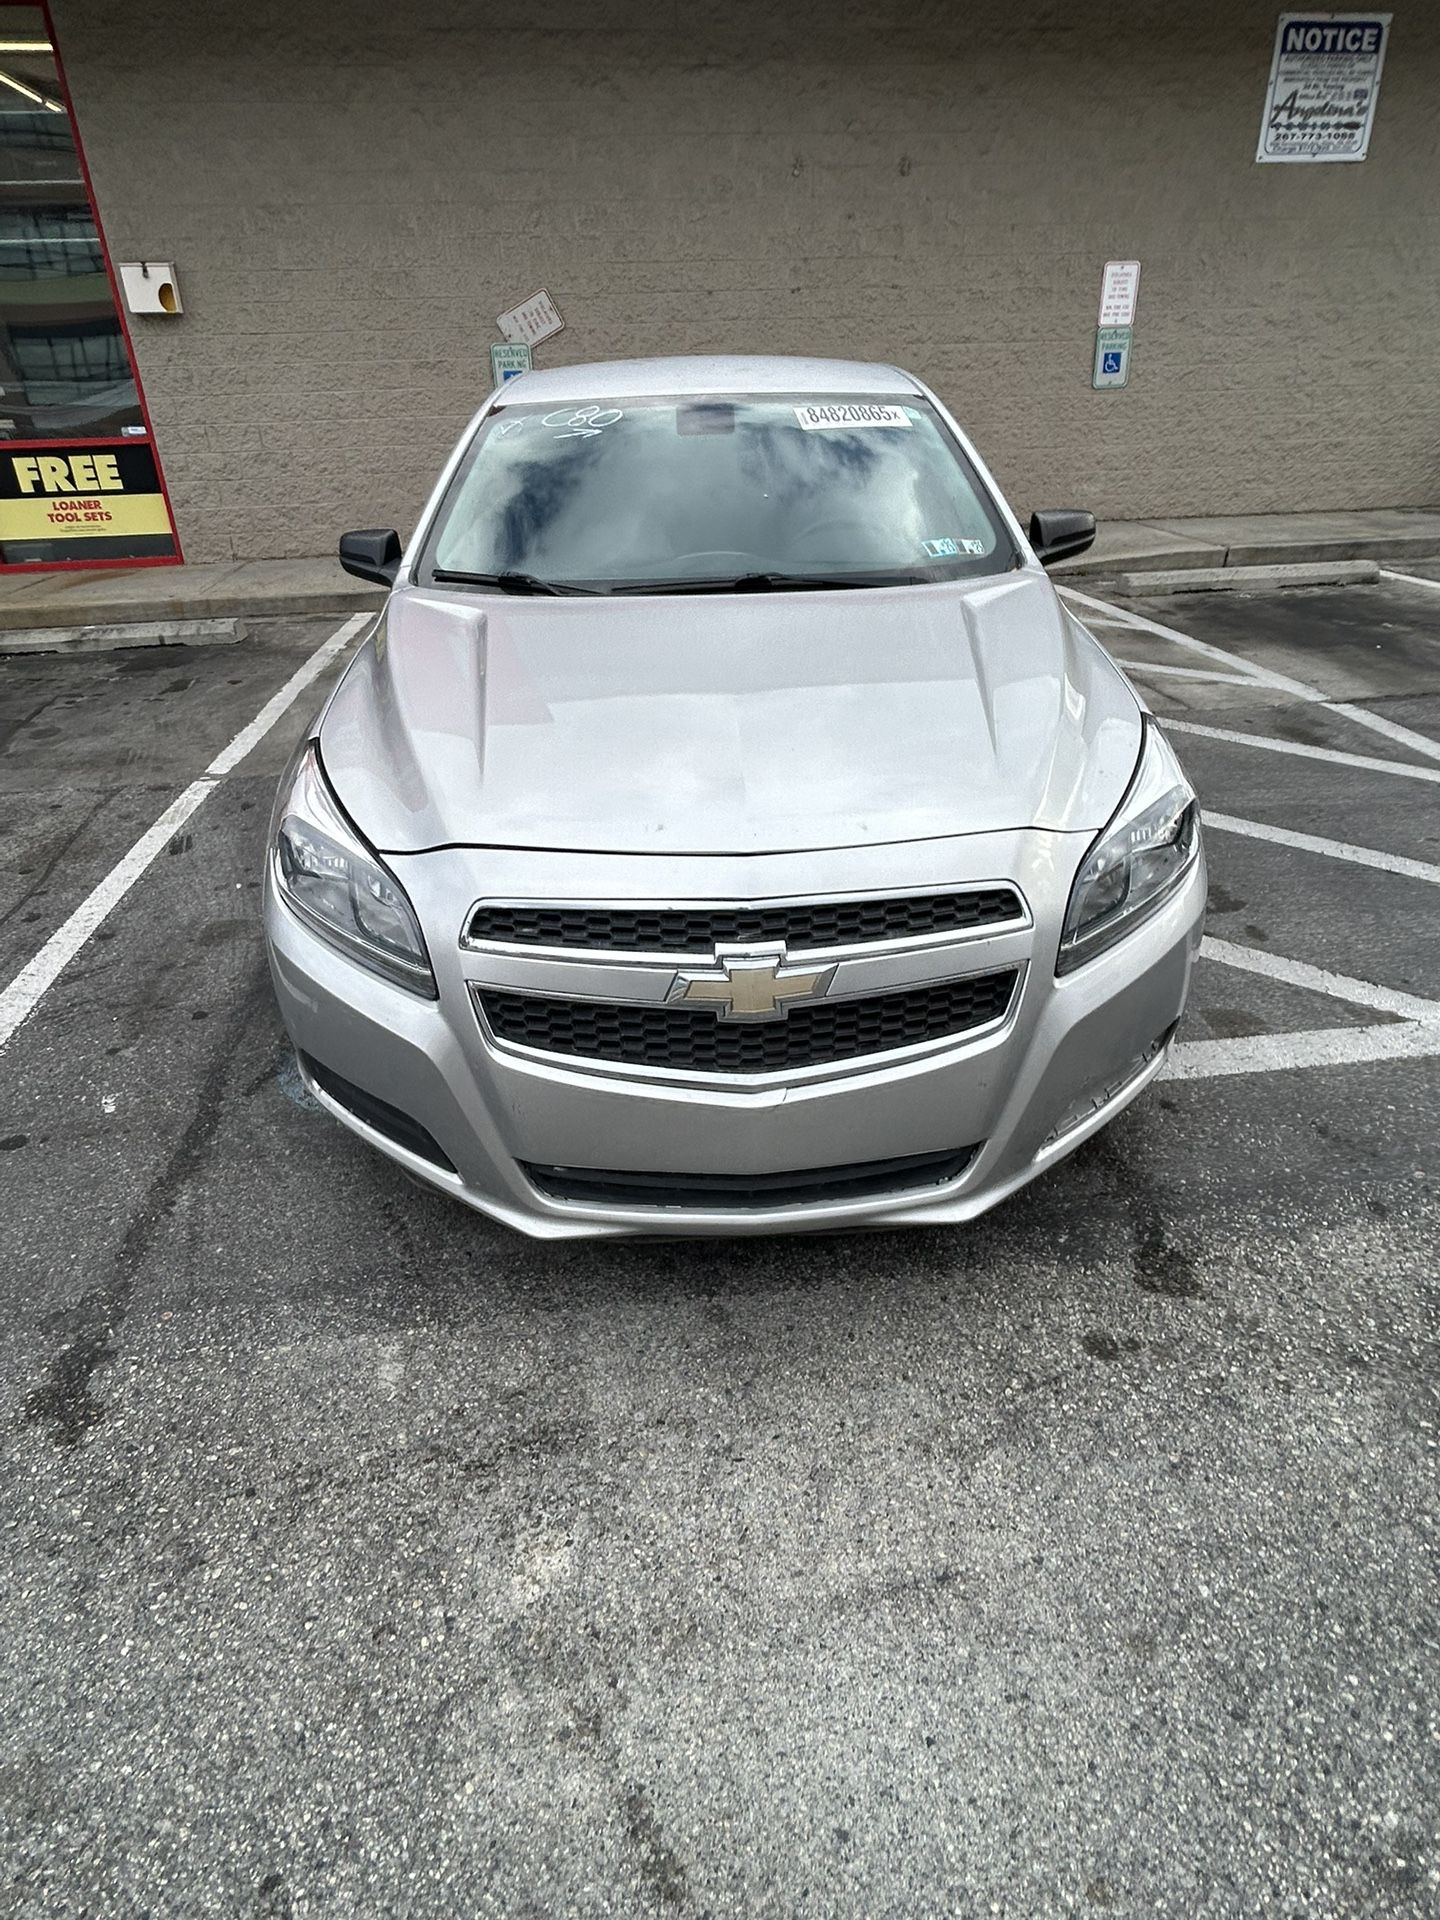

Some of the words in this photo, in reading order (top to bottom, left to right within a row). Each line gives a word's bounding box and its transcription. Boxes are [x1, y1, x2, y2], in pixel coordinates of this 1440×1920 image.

[1286, 27, 1379, 52] NOTICE
[498, 361, 527, 369] PARKNG
[12, 454, 124, 493] FREE
[52, 500, 102, 511] LOANER
[47, 513, 82, 523] TOOL
[84, 511, 112, 522] SETS
